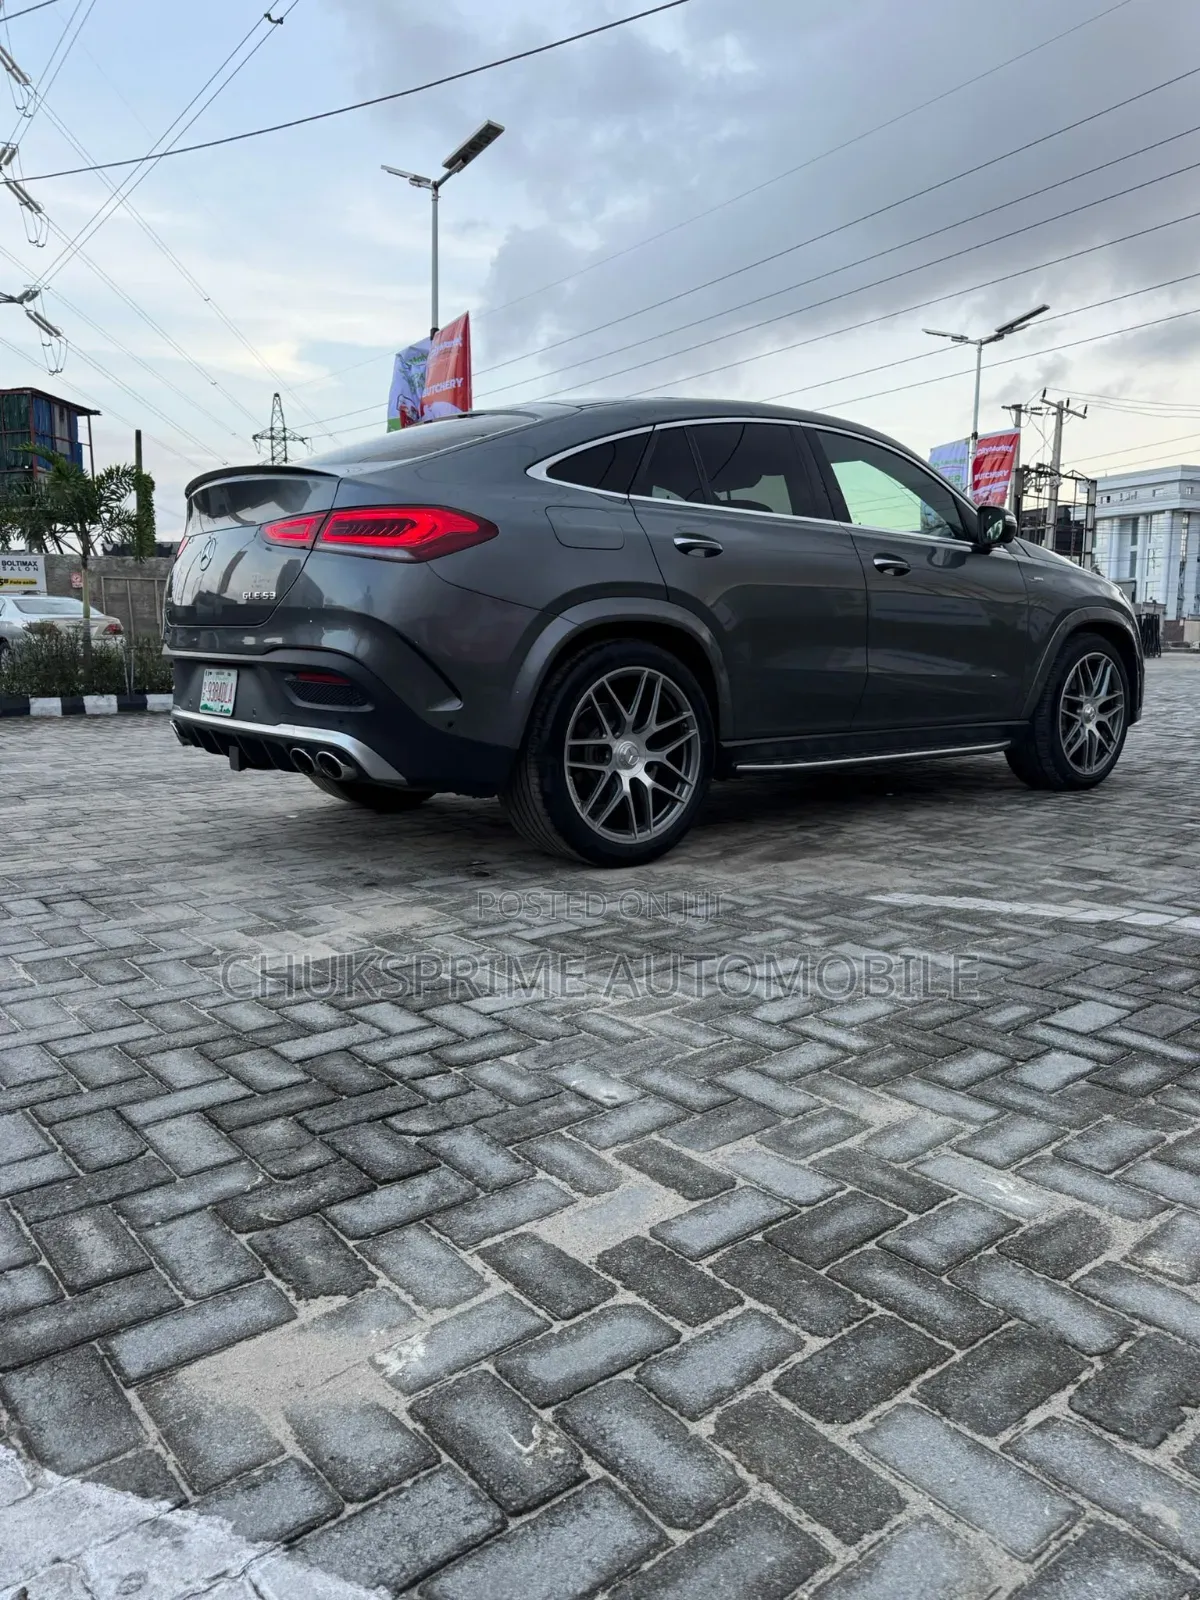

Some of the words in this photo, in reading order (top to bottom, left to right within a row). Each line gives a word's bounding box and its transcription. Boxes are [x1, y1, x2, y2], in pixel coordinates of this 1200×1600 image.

[974, 469, 1009, 481] BUTCHERY
[242, 591, 261, 600] GLE
[262, 591, 276, 600] 53
